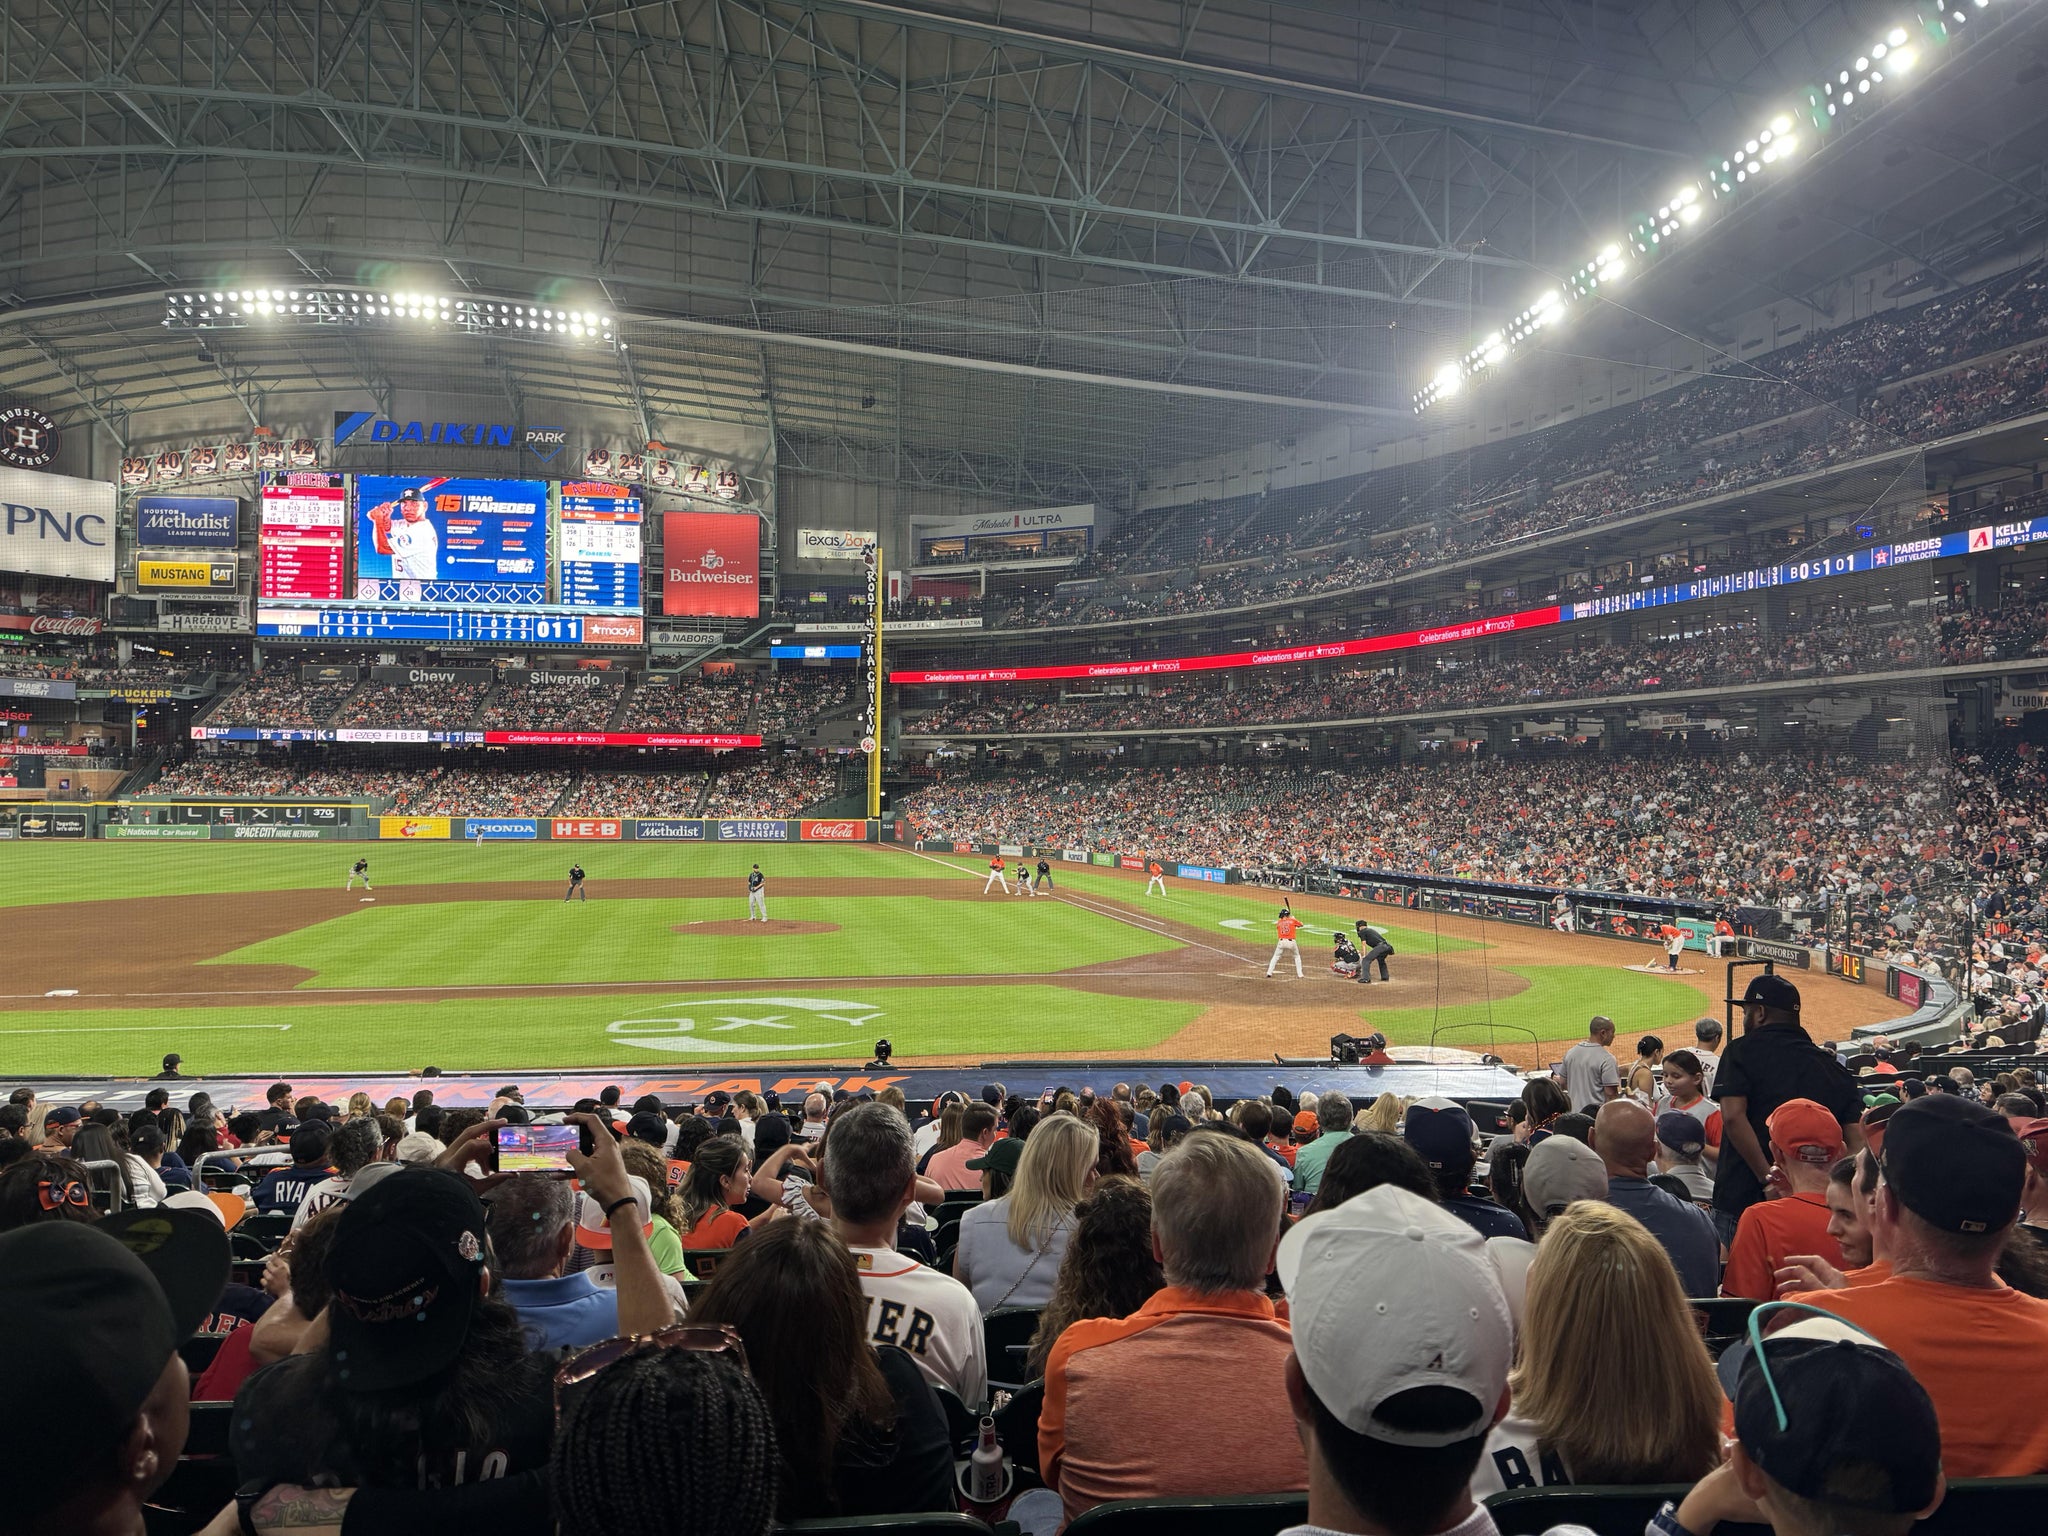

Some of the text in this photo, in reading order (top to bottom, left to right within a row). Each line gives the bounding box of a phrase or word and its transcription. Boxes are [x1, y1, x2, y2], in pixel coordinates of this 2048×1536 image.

[0, 407, 54, 430] HOUSTON
[14, 426, 40, 450] H
[370, 420, 566, 446] DAIKIN PARK
[225, 444, 248, 460] 33
[258, 440, 282, 457] 34
[290, 439, 314, 455] 42
[2, 447, 50, 466] ASTROS
[156, 452, 181, 469] 40
[190, 448, 214, 464] 25
[587, 449, 609, 464] 49
[619, 453, 643, 471] 24
[123, 457, 146, 474] 32
[658, 460, 668, 475] 5
[691, 466, 702, 481] 7
[717, 471, 738, 487] 13
[572, 482, 618, 497] ASTROS
[434, 494, 463, 512] 15
[467, 502, 536, 515] PAREDES
[1, 502, 106, 546] PNC
[144, 512, 231, 529] Methodist
[972, 514, 1063, 531] Michelob ULTRA
[1995, 520, 2033, 538] KELLY
[802, 531, 840, 547] Texas
[1894, 538, 1942, 556] PAREDES
[1995, 536, 2013, 547] RHP,
[2013, 535, 2030, 544] 9-12
[1894, 549, 1941, 564] EXIT VELOCITY:
[150, 568, 233, 581] MUSTANG CAT
[1790, 554, 1854, 580] B 0 S 1 1
[1690, 573, 1767, 596] R H E L
[30, 615, 99, 636] Coca-Cola
[173, 615, 238, 629] HARGROVE
[323, 615, 388, 625] 0 0 0 0
[278, 625, 359, 635] HOU 0 0 3
[537, 621, 577, 638] 0 1 1
[602, 624, 635, 637] macy's
[1418, 615, 1515, 643] Celebrations start at macy's
[672, 634, 715, 643] NABORS
[865, 570, 877, 736] ROOT THA CHIKIN
[1252, 643, 1345, 663] Celebrations start at macy's
[1088, 659, 1180, 675] Celebrations start at macy's
[409, 670, 600, 685] Chevy Silverado
[924, 673, 965, 682] Celebrations
[994, 669, 1017, 679] macy's
[110, 689, 172, 698] PLUCKERS
[317, 730, 327, 740] K
[354, 731, 382, 740] ezee
[386, 732, 423, 740] FIBER
[508, 734, 606, 744] Celebrations start at macy's
[647, 736, 741, 746] Celebrations start at macy's
[15, 745, 71, 756] Budweiser
[127, 828, 159, 836] National
[234, 827, 321, 839] SPACE CITY HOME NETWORK
[483, 824, 536, 833] HONDA
[556, 822, 617, 836] H-E-B
[640, 825, 699, 837] Methodist
[737, 822, 776, 831] ENERGY
[737, 830, 785, 838] TRANSFER
[810, 823, 855, 838] Coca-Cola
[1754, 942, 1800, 960] WOODFOREST
[1901, 983, 1919, 998] reliant
[604, 1012, 887, 1033] OXY
[632, 1075, 918, 1097] PARK
[275, 1180, 305, 1203] RYA
